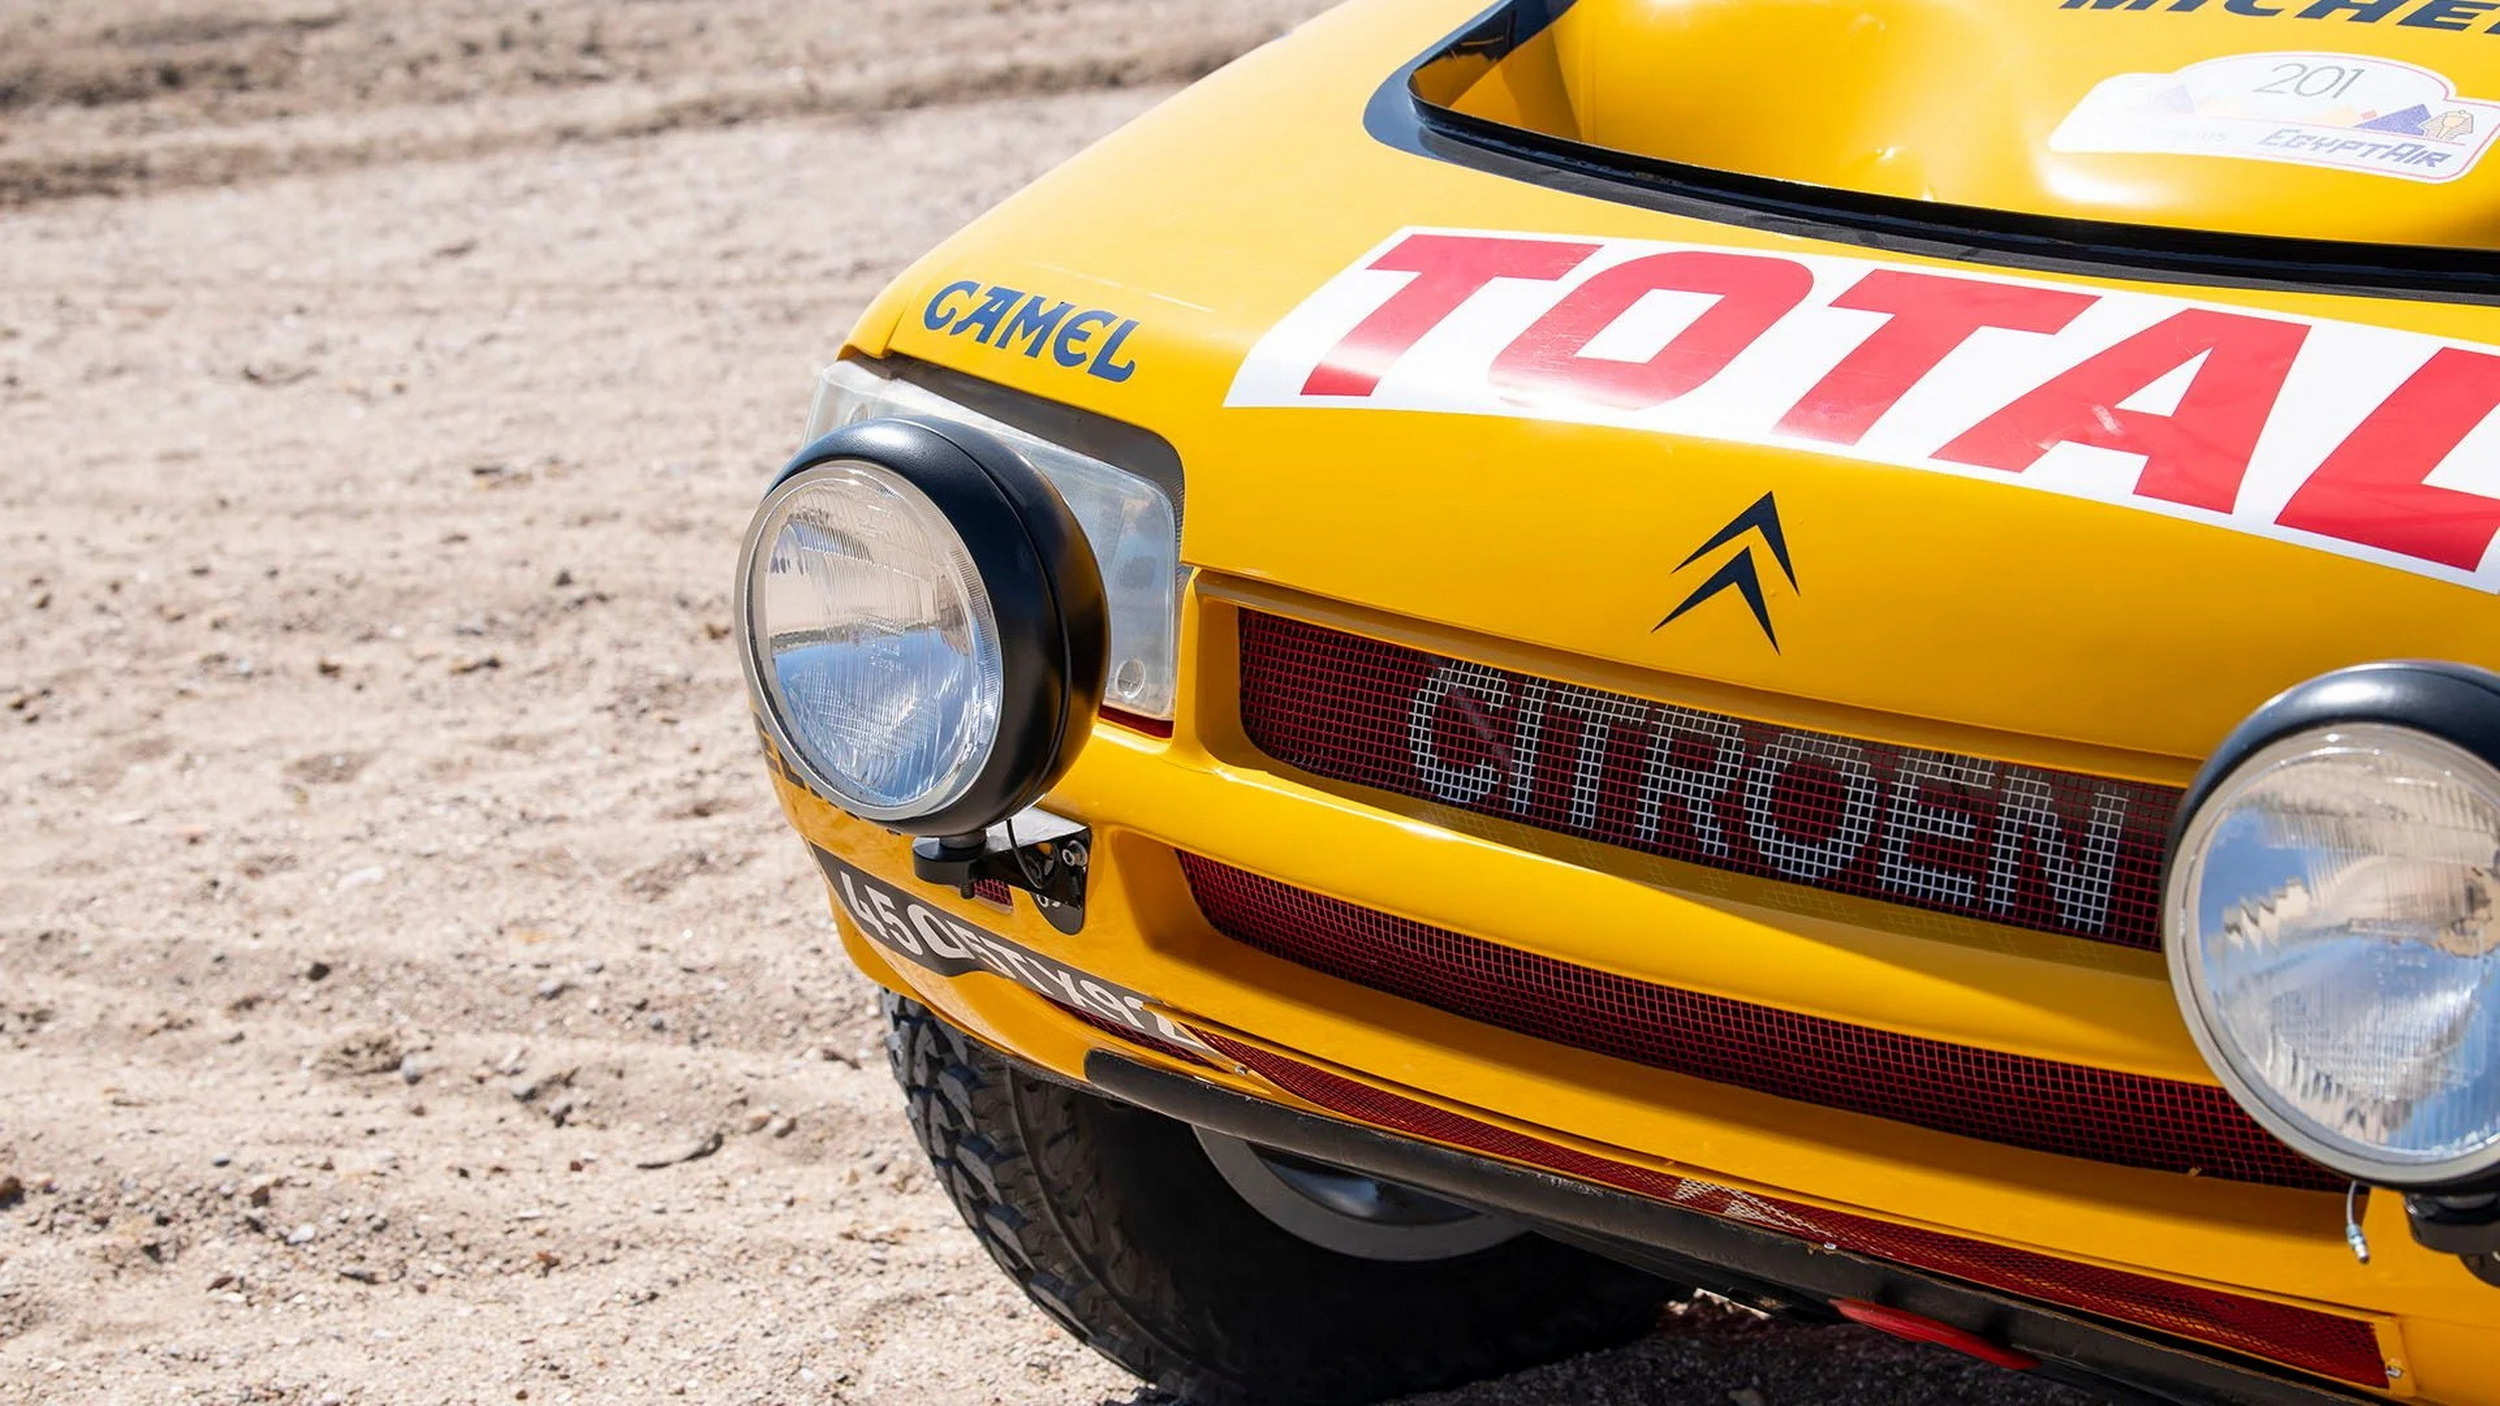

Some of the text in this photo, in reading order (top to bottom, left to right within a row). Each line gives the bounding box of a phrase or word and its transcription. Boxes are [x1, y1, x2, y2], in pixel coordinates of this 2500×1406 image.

[2060, 0, 2500, 36] CHE
[2252, 62, 2366, 100] 201
[923, 280, 1140, 383] CAMEL
[1299, 233, 2500, 573] TOTAL
[1408, 660, 2131, 936] CITROEN
